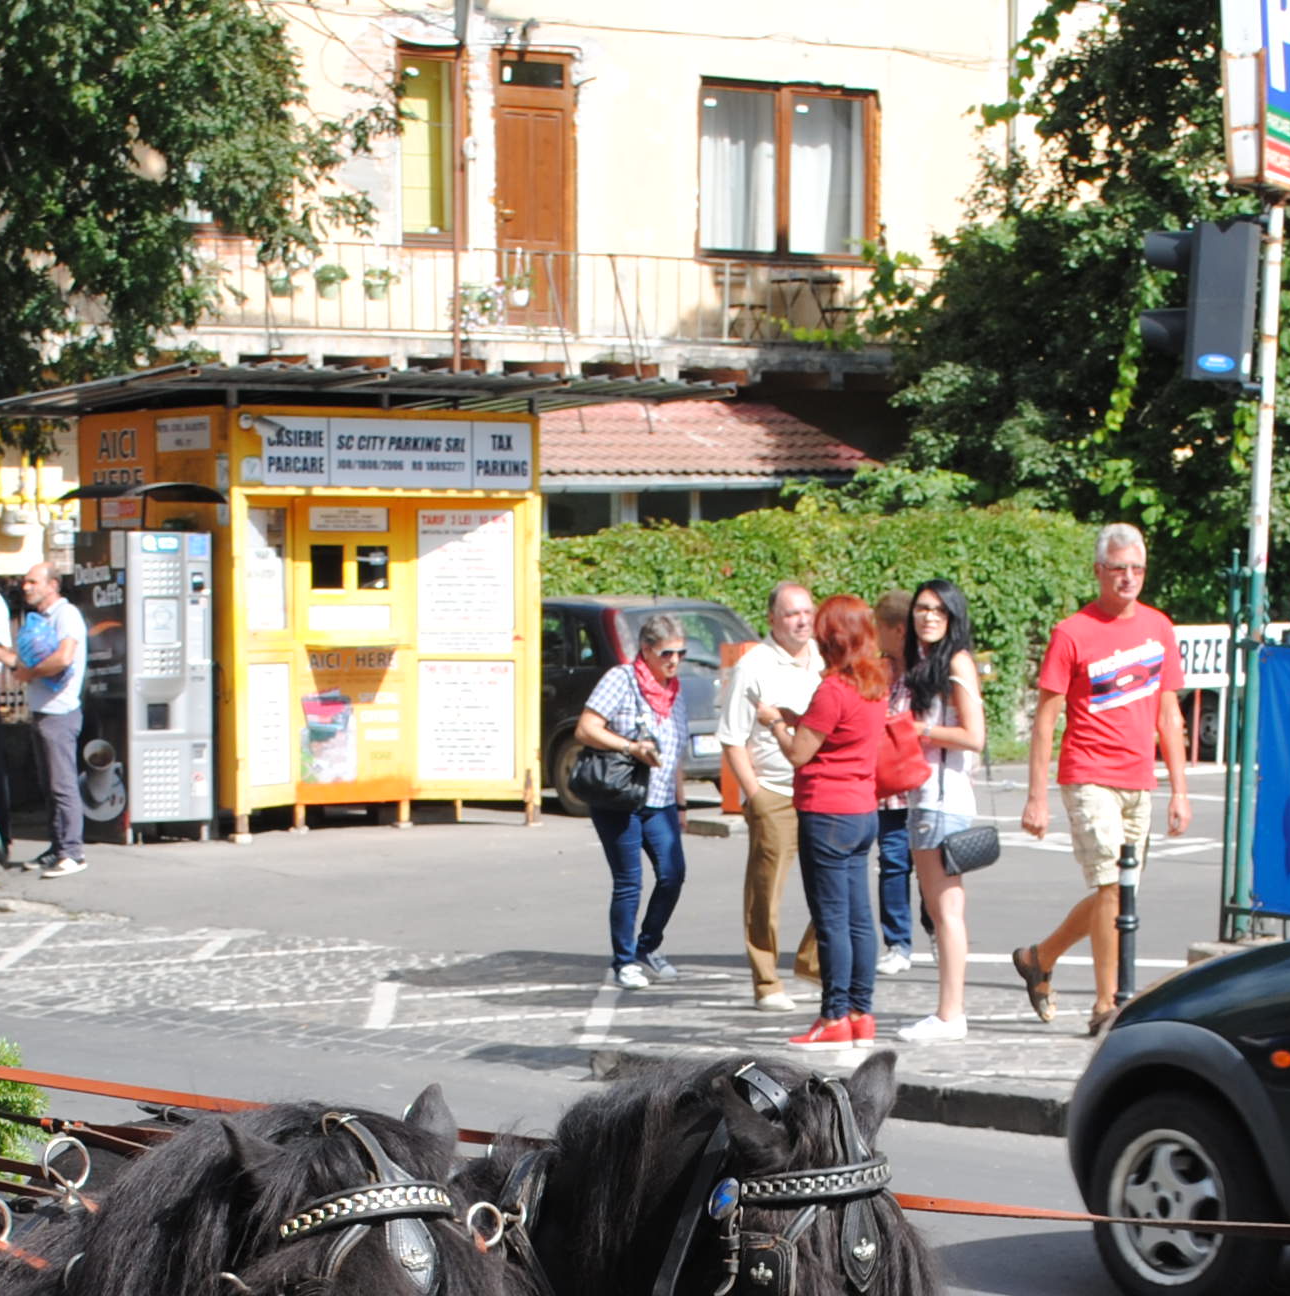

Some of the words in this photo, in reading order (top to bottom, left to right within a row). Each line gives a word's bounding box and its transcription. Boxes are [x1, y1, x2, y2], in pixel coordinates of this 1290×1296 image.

[98, 429, 137, 462] AICI
[337, 434, 354, 450] SC
[357, 435, 385, 451] CITY
[388, 436, 442, 452] PARKING
[445, 437, 465, 453] SRL
[491, 434, 513, 451] TAX
[267, 456, 324, 474] PARCARE
[477, 459, 528, 477] PARKING
[309, 653, 341, 669] AICI
[355, 653, 396, 669] HERE
